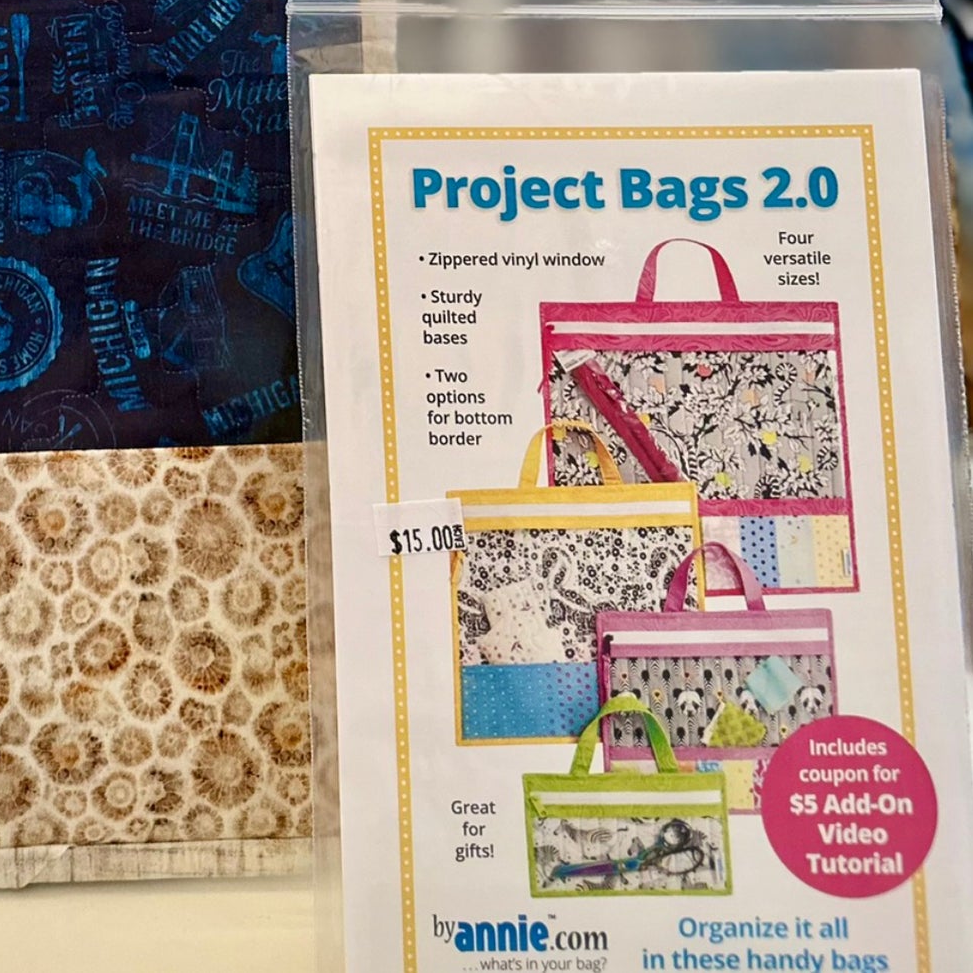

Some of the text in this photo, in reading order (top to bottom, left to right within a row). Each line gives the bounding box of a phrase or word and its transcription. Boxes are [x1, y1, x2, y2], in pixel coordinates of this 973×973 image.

[60, 18, 102, 122] NATURE
[207, 77, 293, 114] Mitte
[413, 165, 839, 222] Project Bags 2.0
[126, 194, 180, 222] MEET
[184, 208, 216, 229] ME
[129, 217, 239, 255] THE BRIDGE
[778, 231, 815, 245] Four
[428, 252, 605, 270] Zippered vinyl window
[763, 250, 832, 265] versatile
[777, 271, 820, 286] sizes!
[430, 289, 483, 308] Sturdy
[421, 310, 477, 328] quilted
[84, 256, 148, 414] MICHIGAN
[422, 330, 468, 345] bases
[11, 330, 46, 371] HOME
[434, 369, 469, 383] Two
[426, 389, 486, 408] options
[427, 410, 513, 425] for bottom
[428, 431, 482, 446] border
[389, 524, 453, 555] $15.00
[809, 737, 888, 756] Includes
[798, 763, 901, 788] coupon for
[451, 799, 497, 815] Great
[789, 792, 914, 816] $5 Add-On
[462, 821, 487, 837] for
[817, 822, 889, 845] Video
[455, 843, 495, 863] gifts!
[805, 852, 904, 875] Tutorial
[678, 916, 849, 945] Organize it all
[527, 958, 538, 971] in
[542, 959, 572, 973] your
[576, 956, 607, 973] bag?
[642, 948, 890, 973] in these handy bags
